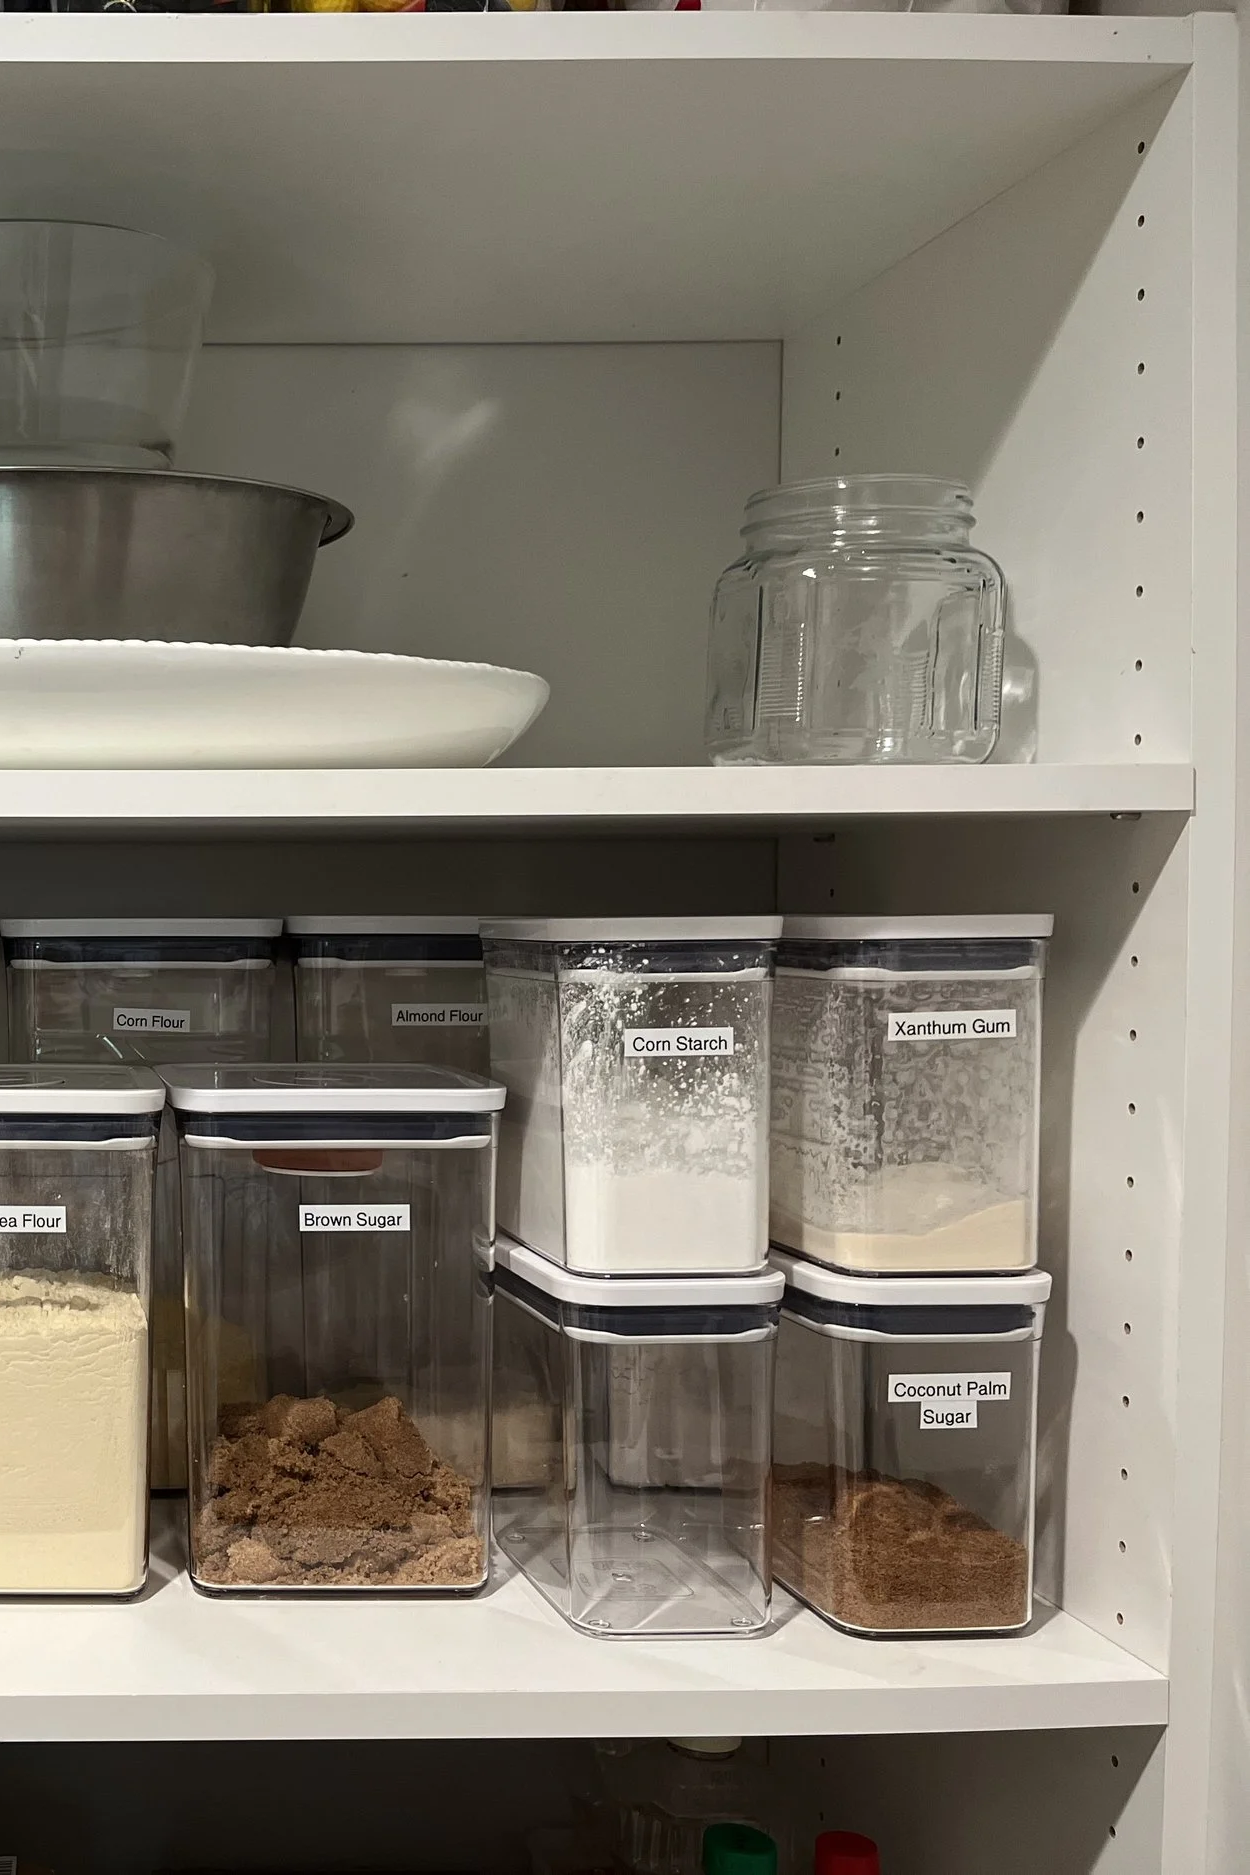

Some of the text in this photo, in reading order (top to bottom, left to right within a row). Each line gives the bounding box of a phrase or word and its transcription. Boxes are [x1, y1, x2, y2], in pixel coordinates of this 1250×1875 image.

[116, 1013, 185, 1029] Corn Flour
[396, 1009, 483, 1023] Almond Flour
[895, 1018, 1010, 1036] Xanthum Gum
[632, 1035, 727, 1052] Corn Starch
[22, 1213, 61, 1229] Flour
[304, 1212, 402, 1229] Brown Sugar
[894, 1381, 1007, 1398] Coconut Palm
[923, 1408, 971, 1427] Sugar
